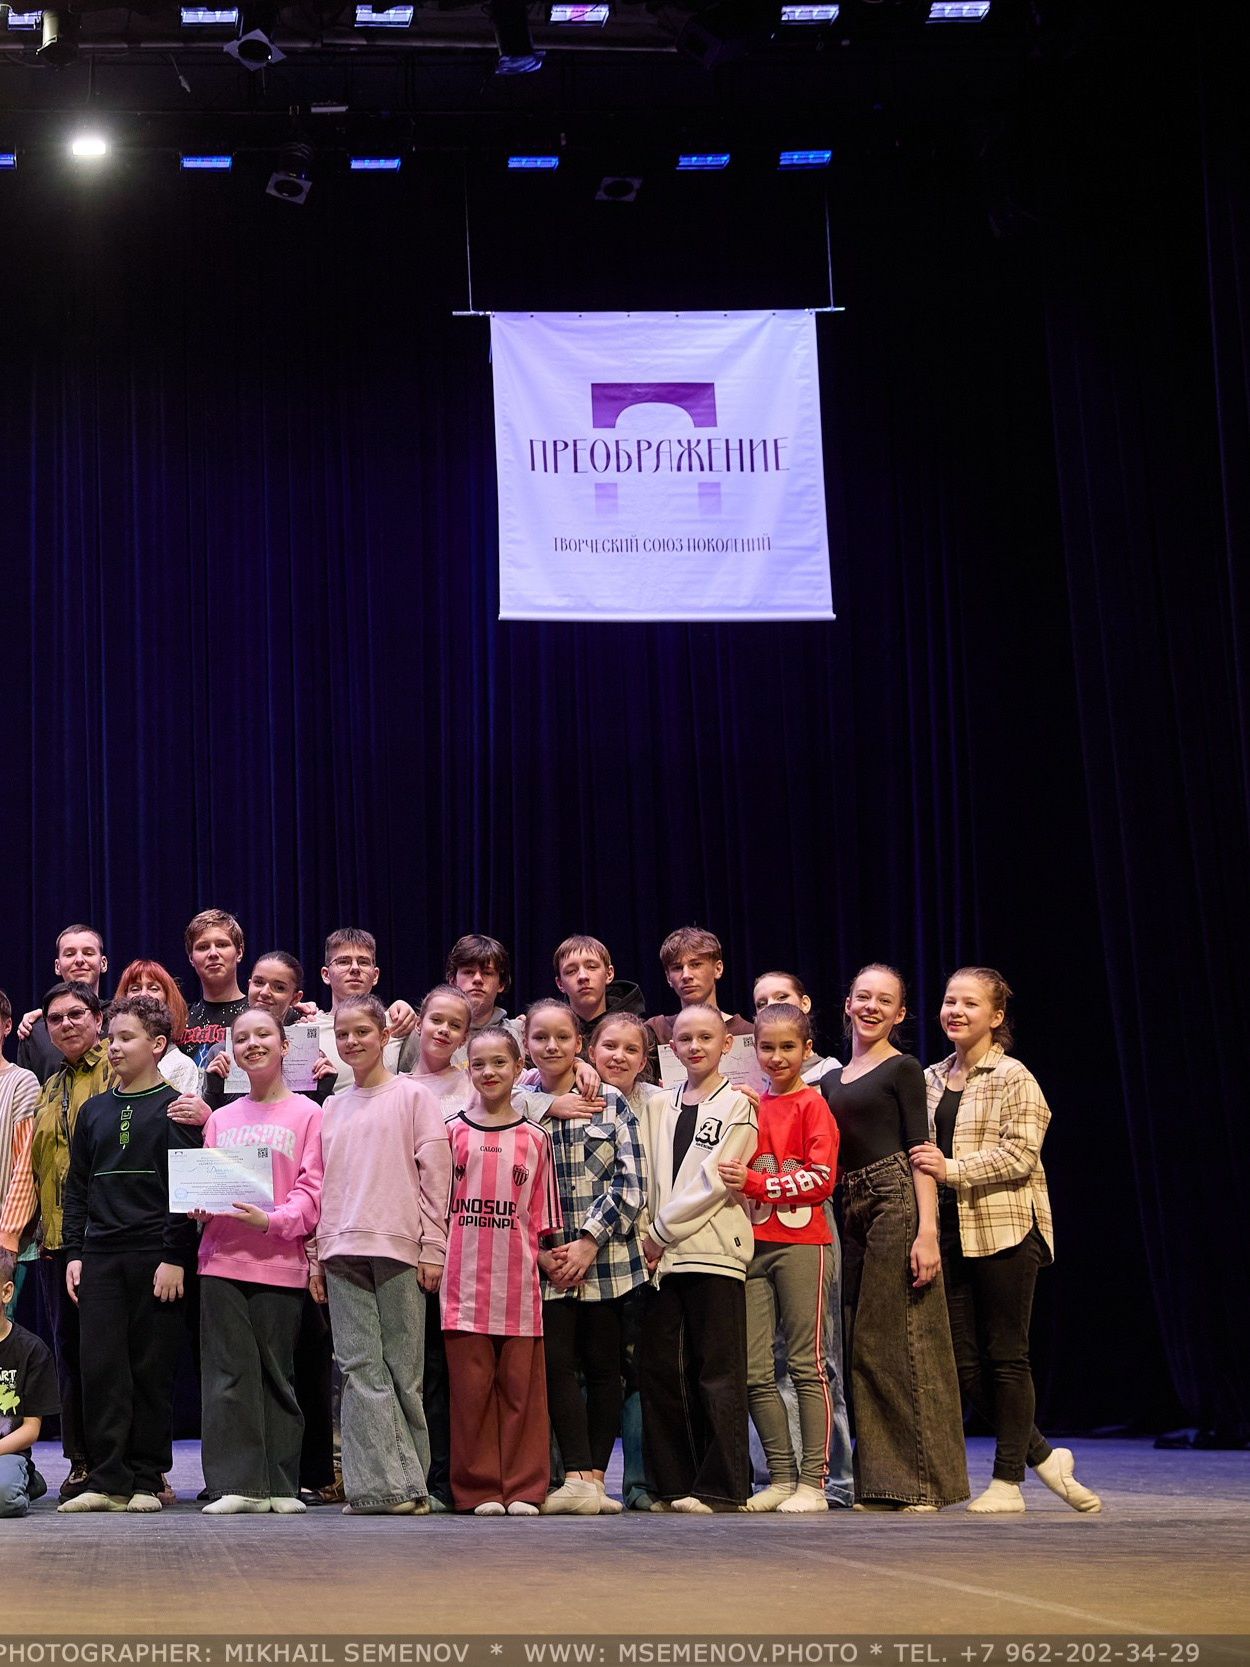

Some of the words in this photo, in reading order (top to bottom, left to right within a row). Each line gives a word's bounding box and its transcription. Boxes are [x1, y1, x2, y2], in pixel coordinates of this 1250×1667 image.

[529, 437, 790, 474] ПРЕОБРАЖЕНИЕ
[552, 534, 639, 553] ТВОРЧЕСКИЙ
[643, 538, 683, 553] СОЮЗ
[687, 533, 772, 552] ПОКОЛЕНИЙ
